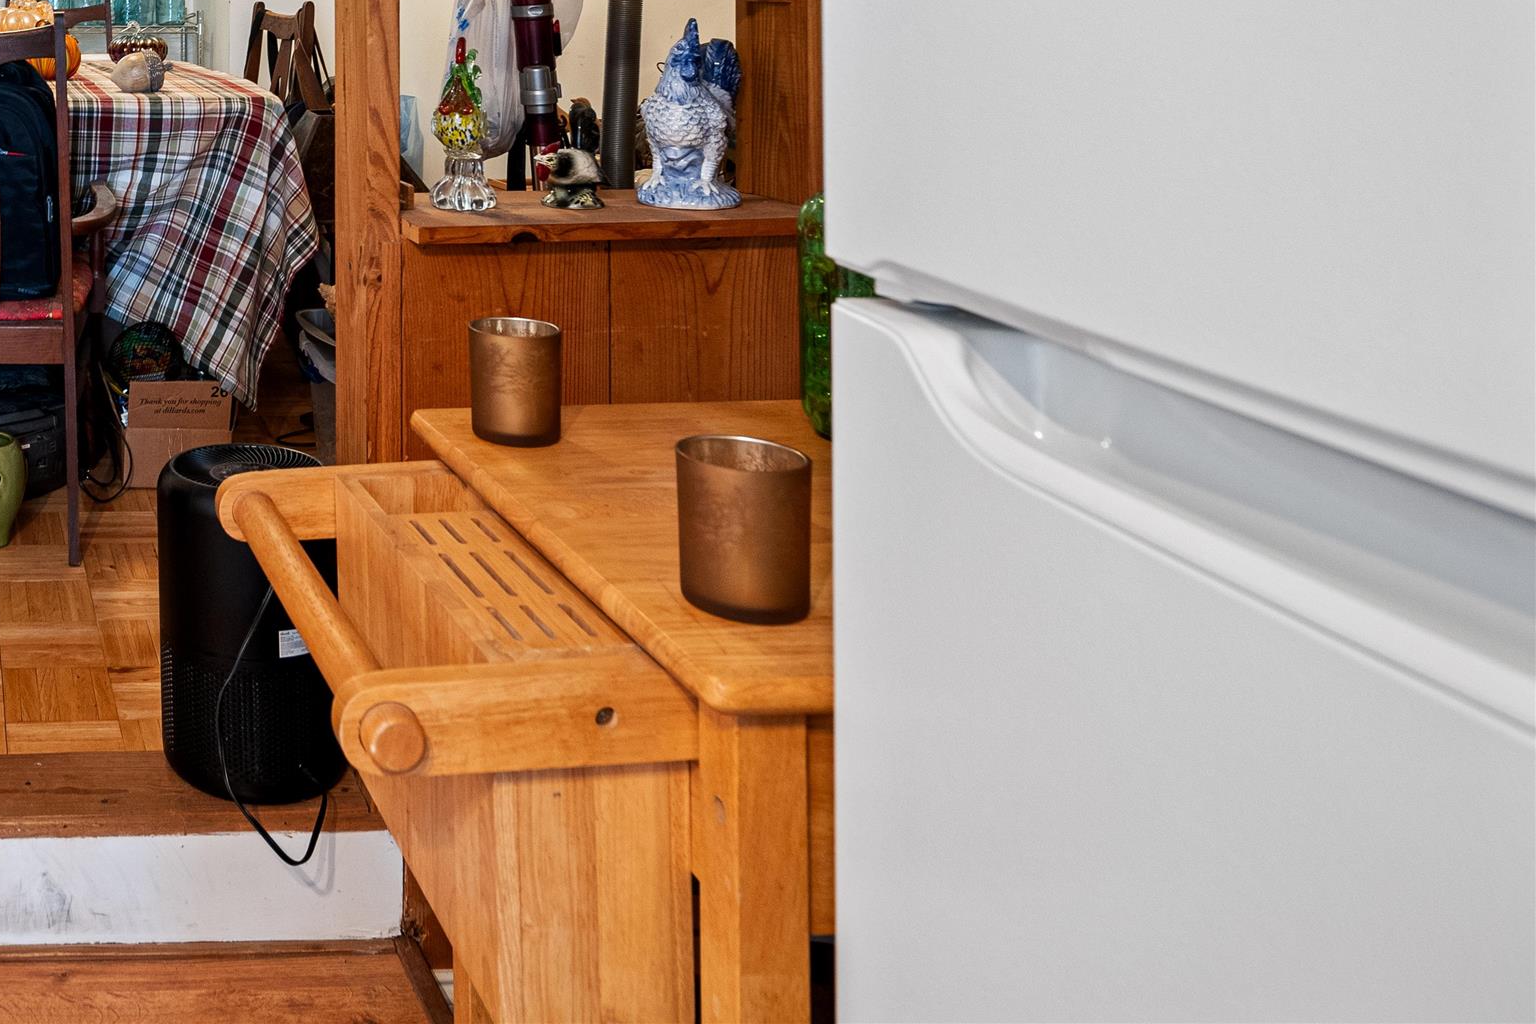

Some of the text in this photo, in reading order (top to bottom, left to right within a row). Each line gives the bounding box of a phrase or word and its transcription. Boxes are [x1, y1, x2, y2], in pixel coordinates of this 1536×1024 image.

[140, 398, 162, 406] Thank
[176, 397, 188, 408] for
[190, 398, 222, 408] shopping
[162, 406, 206, 414] dillards.com
